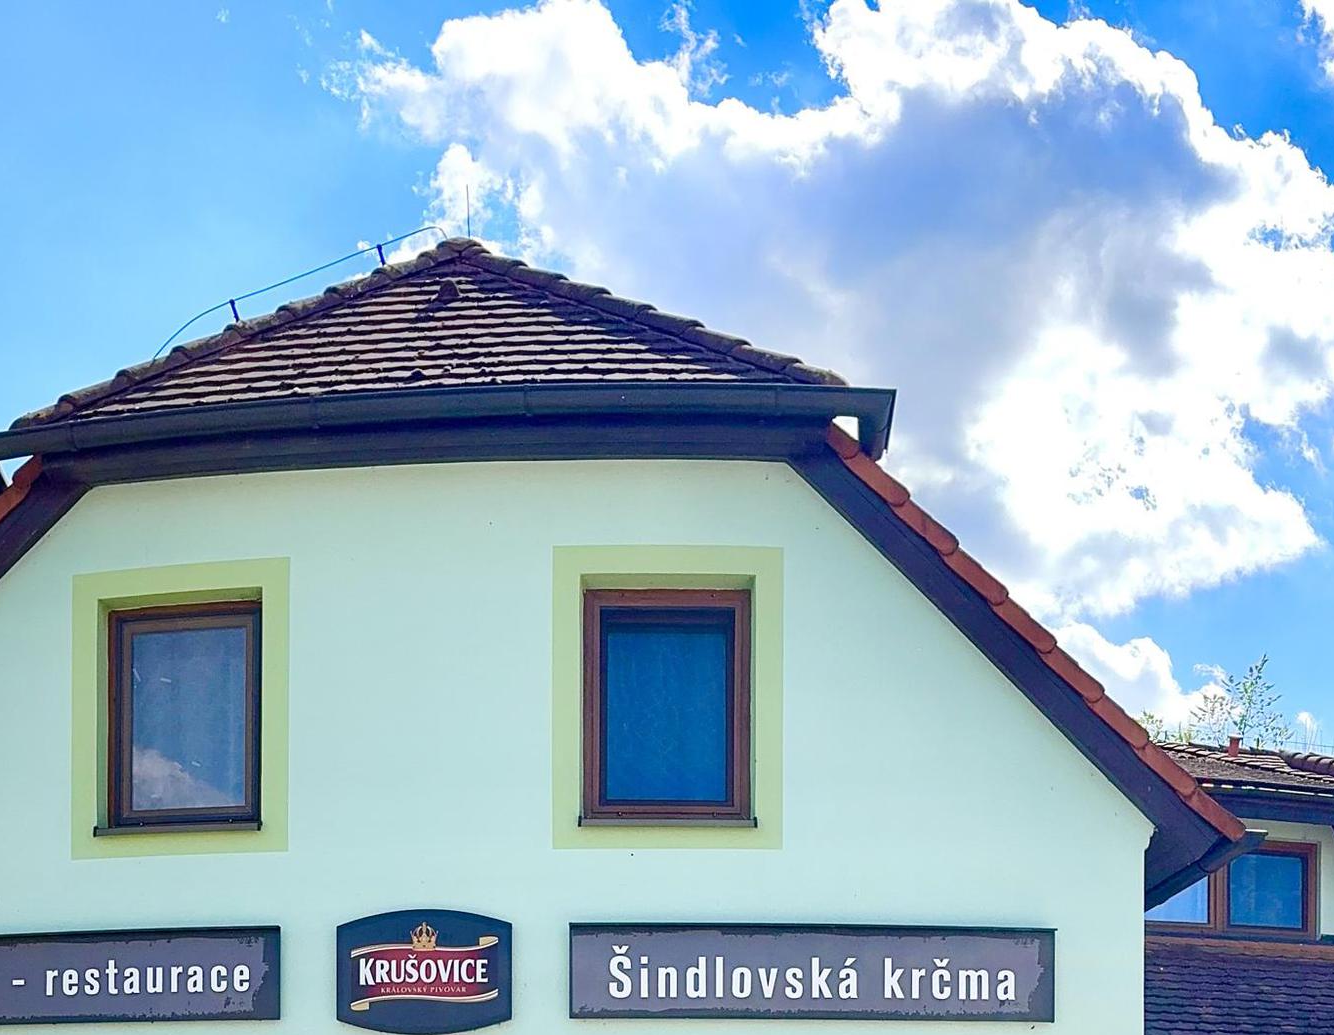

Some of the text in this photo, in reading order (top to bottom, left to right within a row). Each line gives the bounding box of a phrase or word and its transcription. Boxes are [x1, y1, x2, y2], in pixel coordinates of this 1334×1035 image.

[45, 959, 251, 997] restaurace
[359, 954, 489, 985] KRUŠOVICE
[608, 945, 1017, 1001] Šindlovská krčma
[430, 985, 467, 993] PIVOVAR
